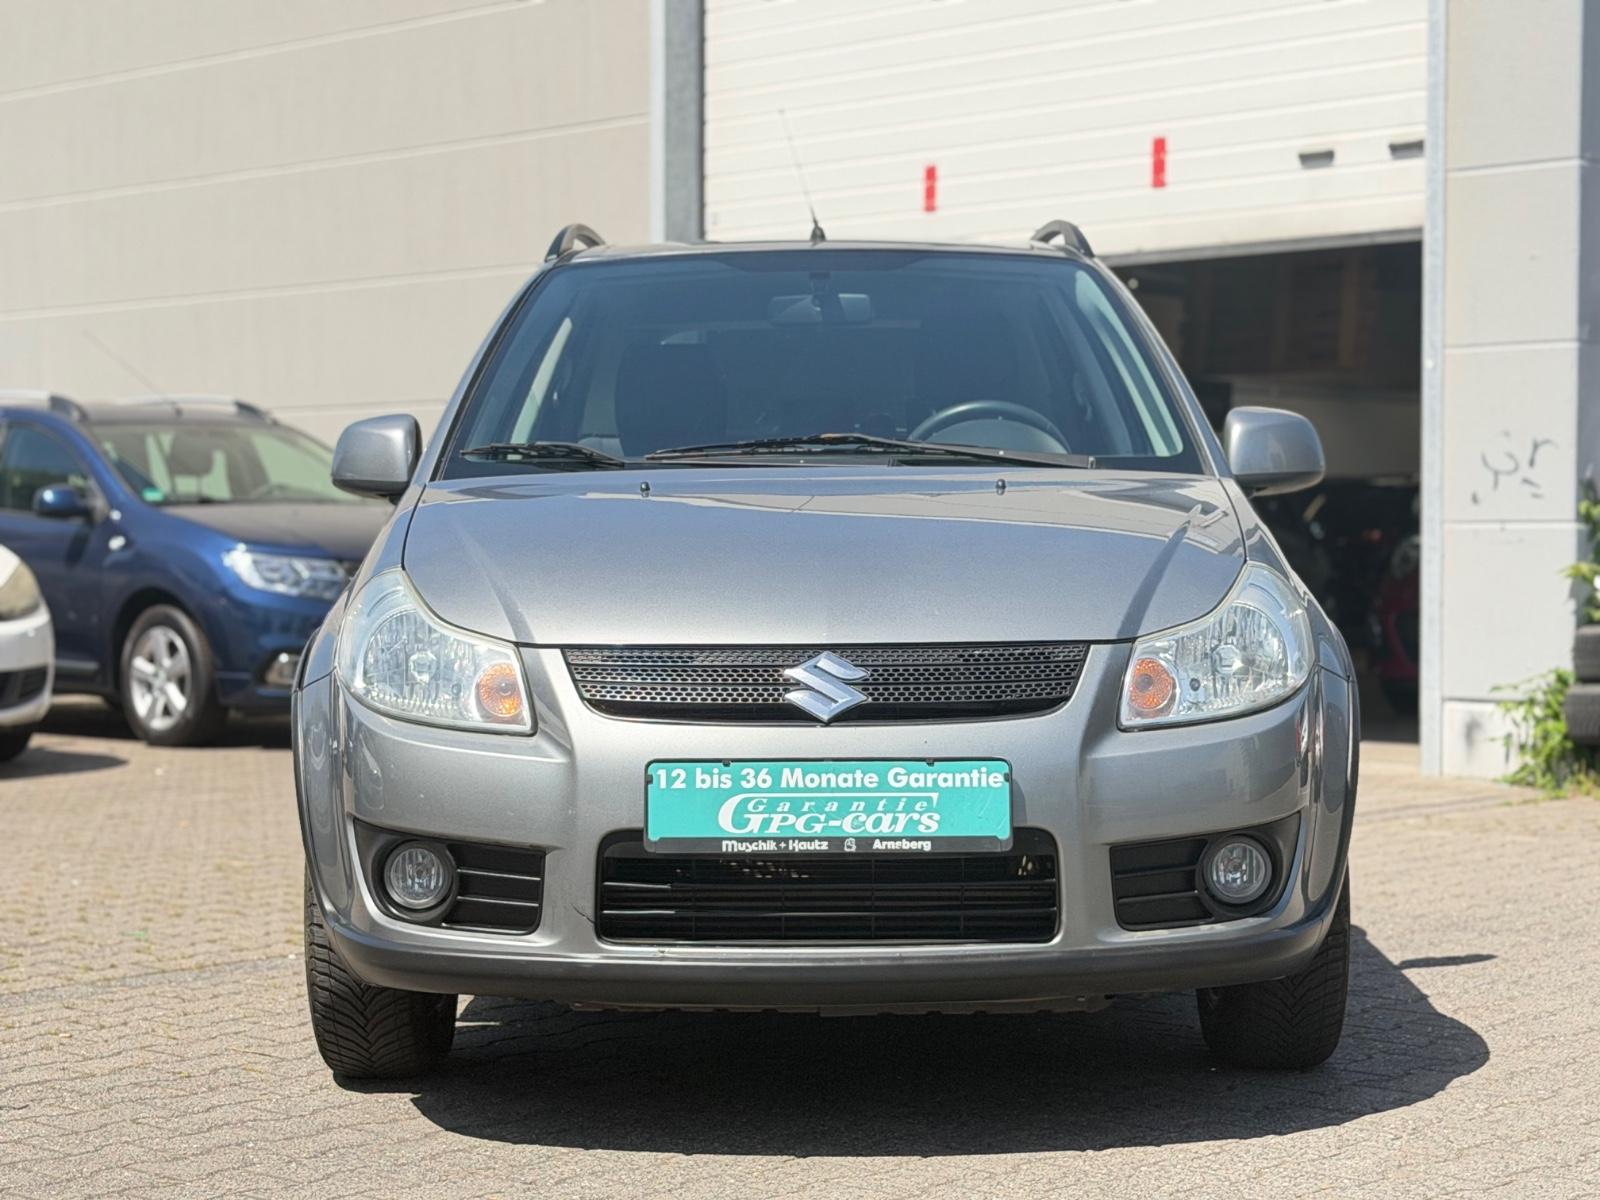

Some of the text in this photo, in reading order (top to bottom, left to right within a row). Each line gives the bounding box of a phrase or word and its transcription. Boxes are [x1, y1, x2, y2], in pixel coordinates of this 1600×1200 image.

[656, 766, 1004, 789] 12 bis 36 Monate Garantie
[747, 797, 928, 813] Garantie
[872, 838, 932, 852] Arnsberg
